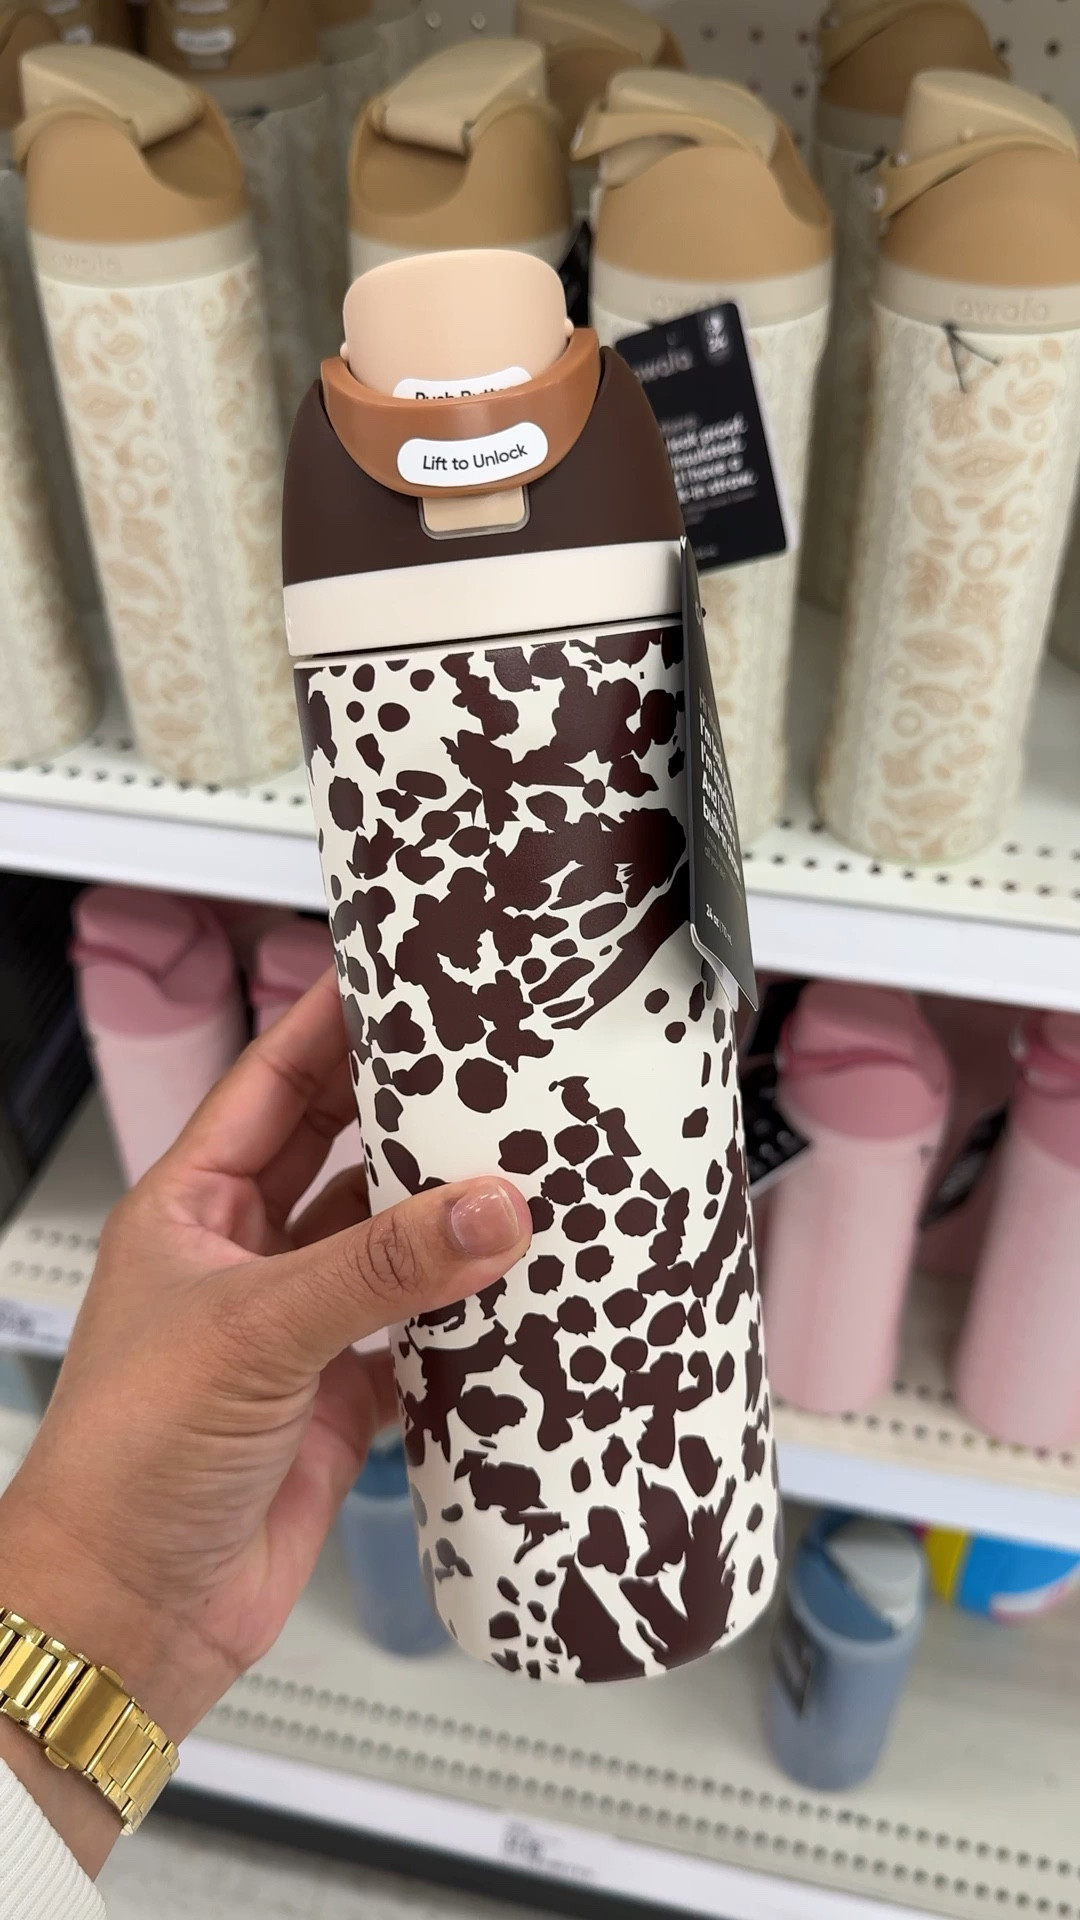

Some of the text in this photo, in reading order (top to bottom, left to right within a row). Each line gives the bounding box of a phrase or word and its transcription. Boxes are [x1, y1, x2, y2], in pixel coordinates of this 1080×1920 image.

[422, 444, 528, 471] Lift to Unlock
[700, 713, 712, 750] I'm
[700, 740, 713, 777] I'm
[702, 769, 718, 809] And
